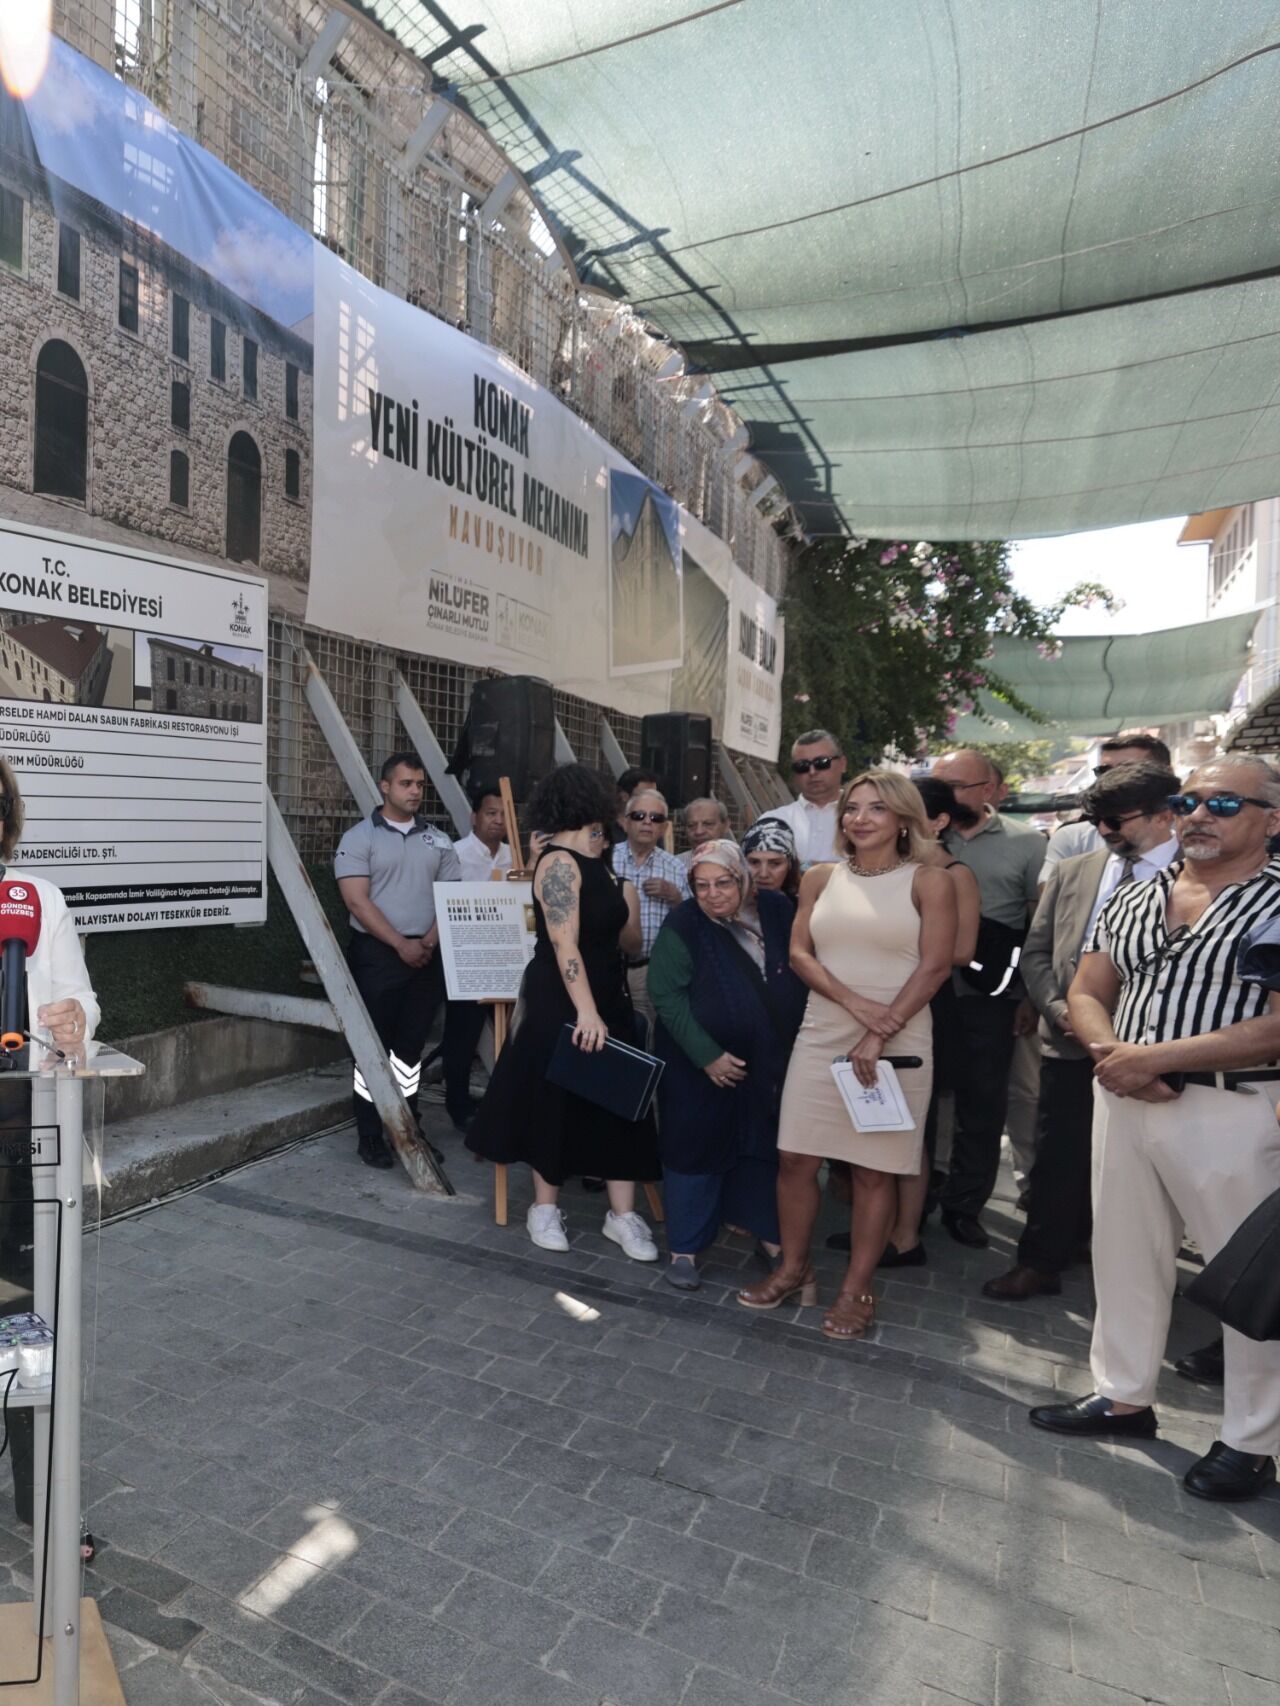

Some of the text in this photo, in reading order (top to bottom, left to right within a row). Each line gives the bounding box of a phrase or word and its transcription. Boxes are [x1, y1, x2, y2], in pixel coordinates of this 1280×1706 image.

[474, 374, 530, 458] KONAK
[368, 387, 588, 559] YENİ KÜLTÜREL MEKANINA
[449, 504, 543, 576] KAVUŞUYOR
[42, 557, 71, 577] T.C.
[68, 583, 163, 618] BELEDİYESİ
[462, 614, 489, 633] MUTLU
[36, 709, 67, 722] HAMDİ
[68, 712, 98, 724] DALAN
[100, 715, 128, 727] SABUN
[130, 717, 170, 730] FABRİKASI
[172, 722, 229, 736] RESTORASYONU
[230, 725, 239, 738] İŞİ
[27, 754, 84, 769] MÜDÜRLÜĞÜ
[21, 846, 81, 860] MADENCİLİĞİ
[83, 848, 100, 858] LTD.
[102, 845, 118, 860] ŞTİ.
[11, 888, 26, 897] 35
[85, 890, 128, 902] Kapsamında
[129, 888, 145, 898] İzmir
[178, 887, 208, 898] Uygulama
[209, 886, 231, 896] Desteği
[1, 902, 34, 911] GÜNDEM
[1, 909, 34, 918] OTUZBEŞ
[74, 913, 125, 926] NLAYISTAN
[127, 911, 159, 922] DOLAYI
